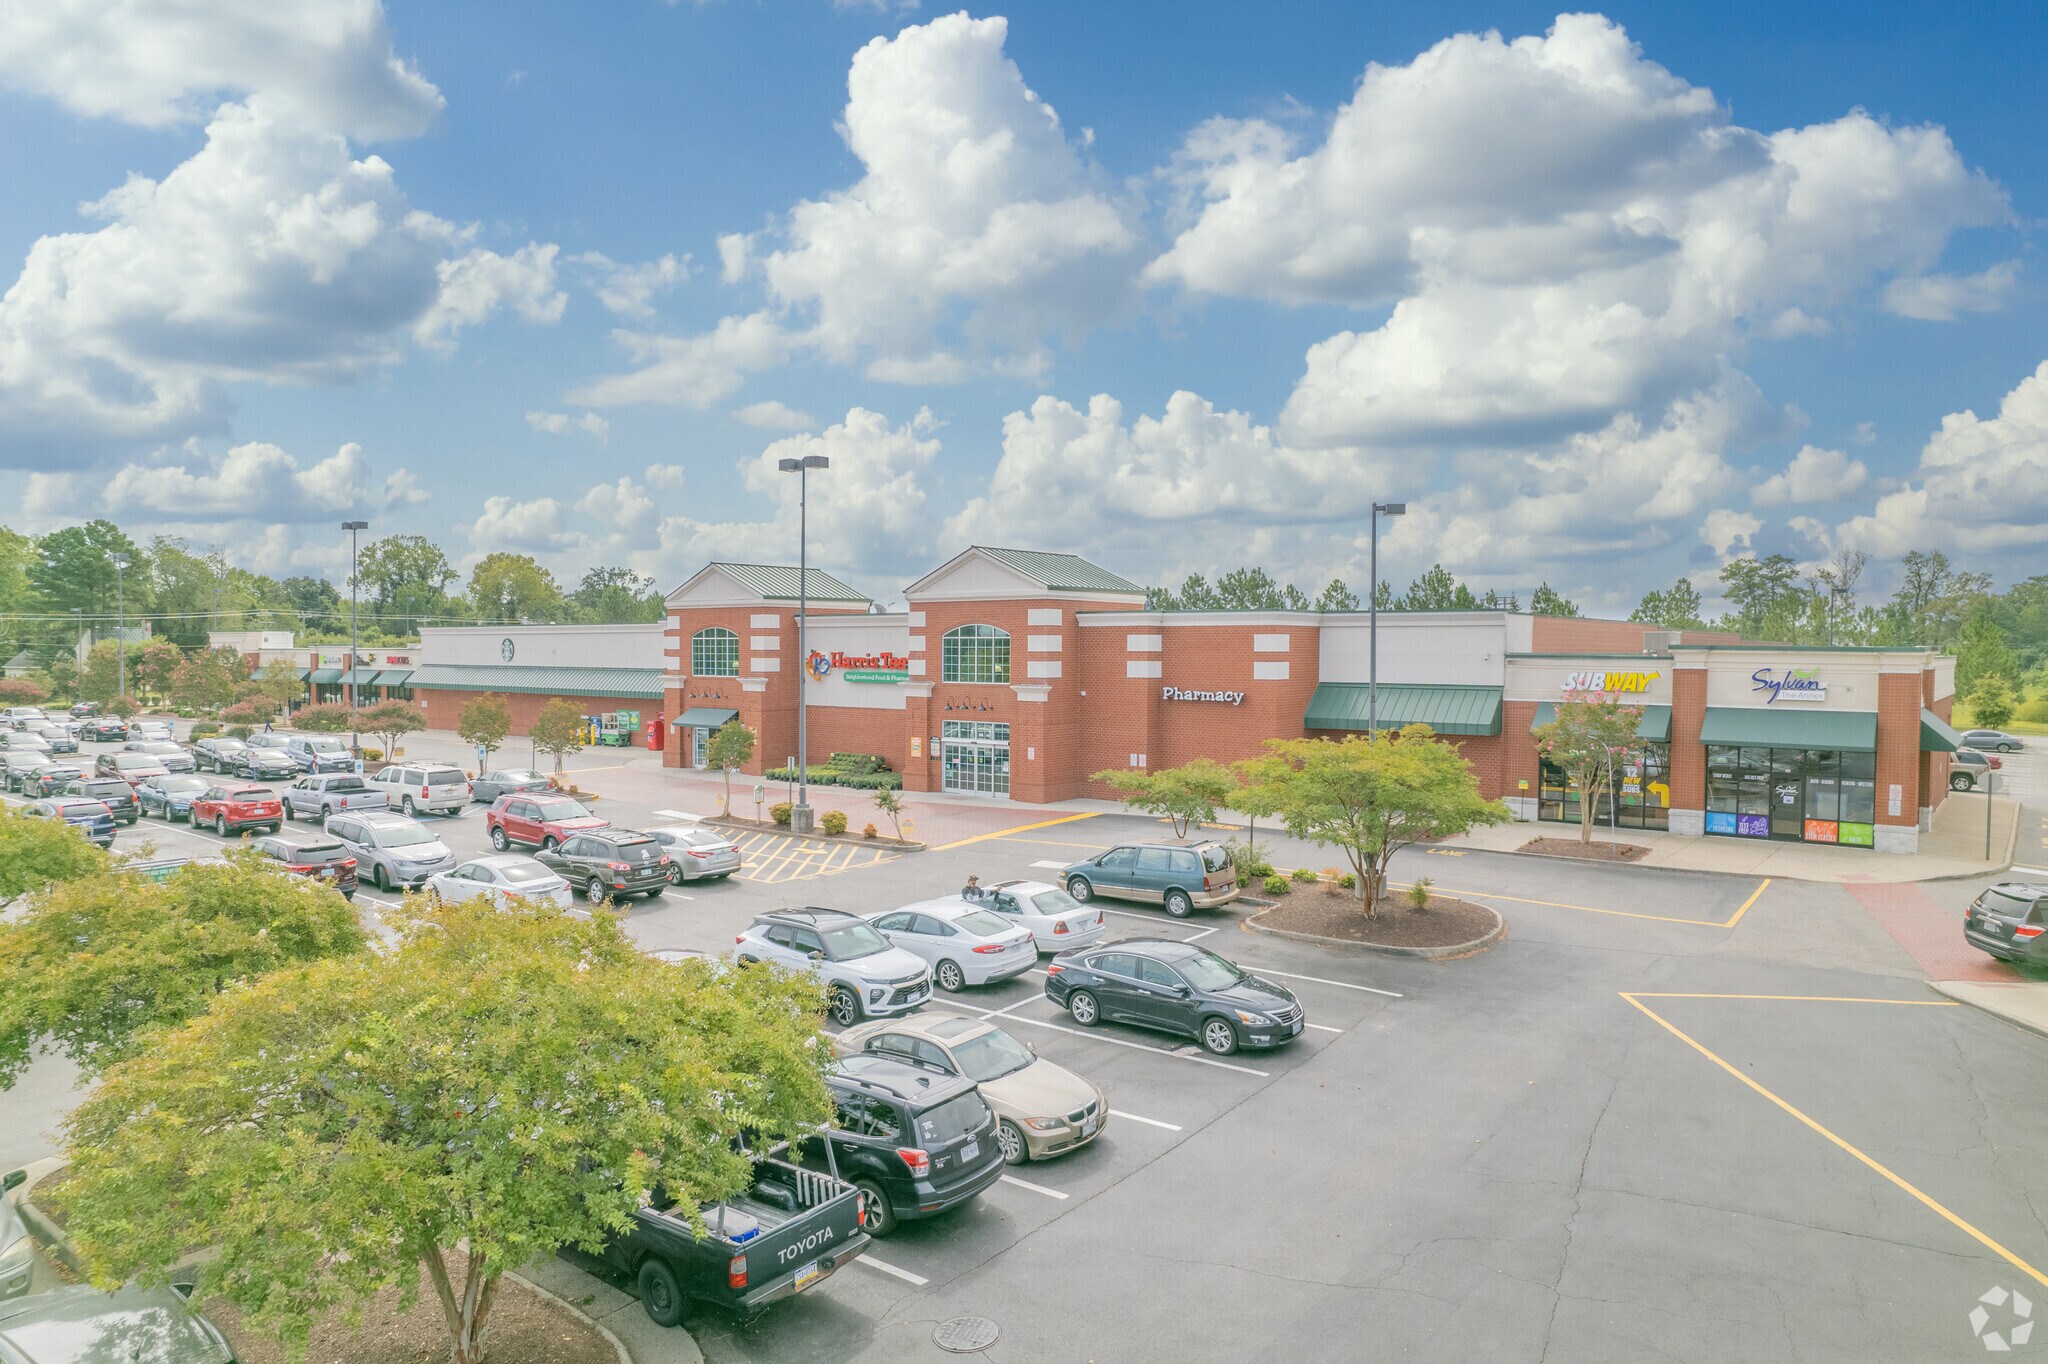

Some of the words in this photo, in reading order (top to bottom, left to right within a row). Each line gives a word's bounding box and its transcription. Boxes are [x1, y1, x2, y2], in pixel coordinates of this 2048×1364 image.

[830, 651, 880, 669] Harris
[845, 674, 875, 682] Neighborhood
[1560, 671, 1661, 692] SUBWAY
[1751, 668, 1827, 704] Sylvan
[1162, 686, 1245, 706] Pharmacy
[1780, 691, 1797, 699] The
[1797, 691, 1824, 700] Annex
[1626, 767, 1638, 777] 12
[1775, 785, 1799, 797] Sylvan
[1712, 824, 1734, 833] TUTORING
[1817, 833, 1837, 842] CLASSES
[777, 1226, 834, 1264] TOYOTA
